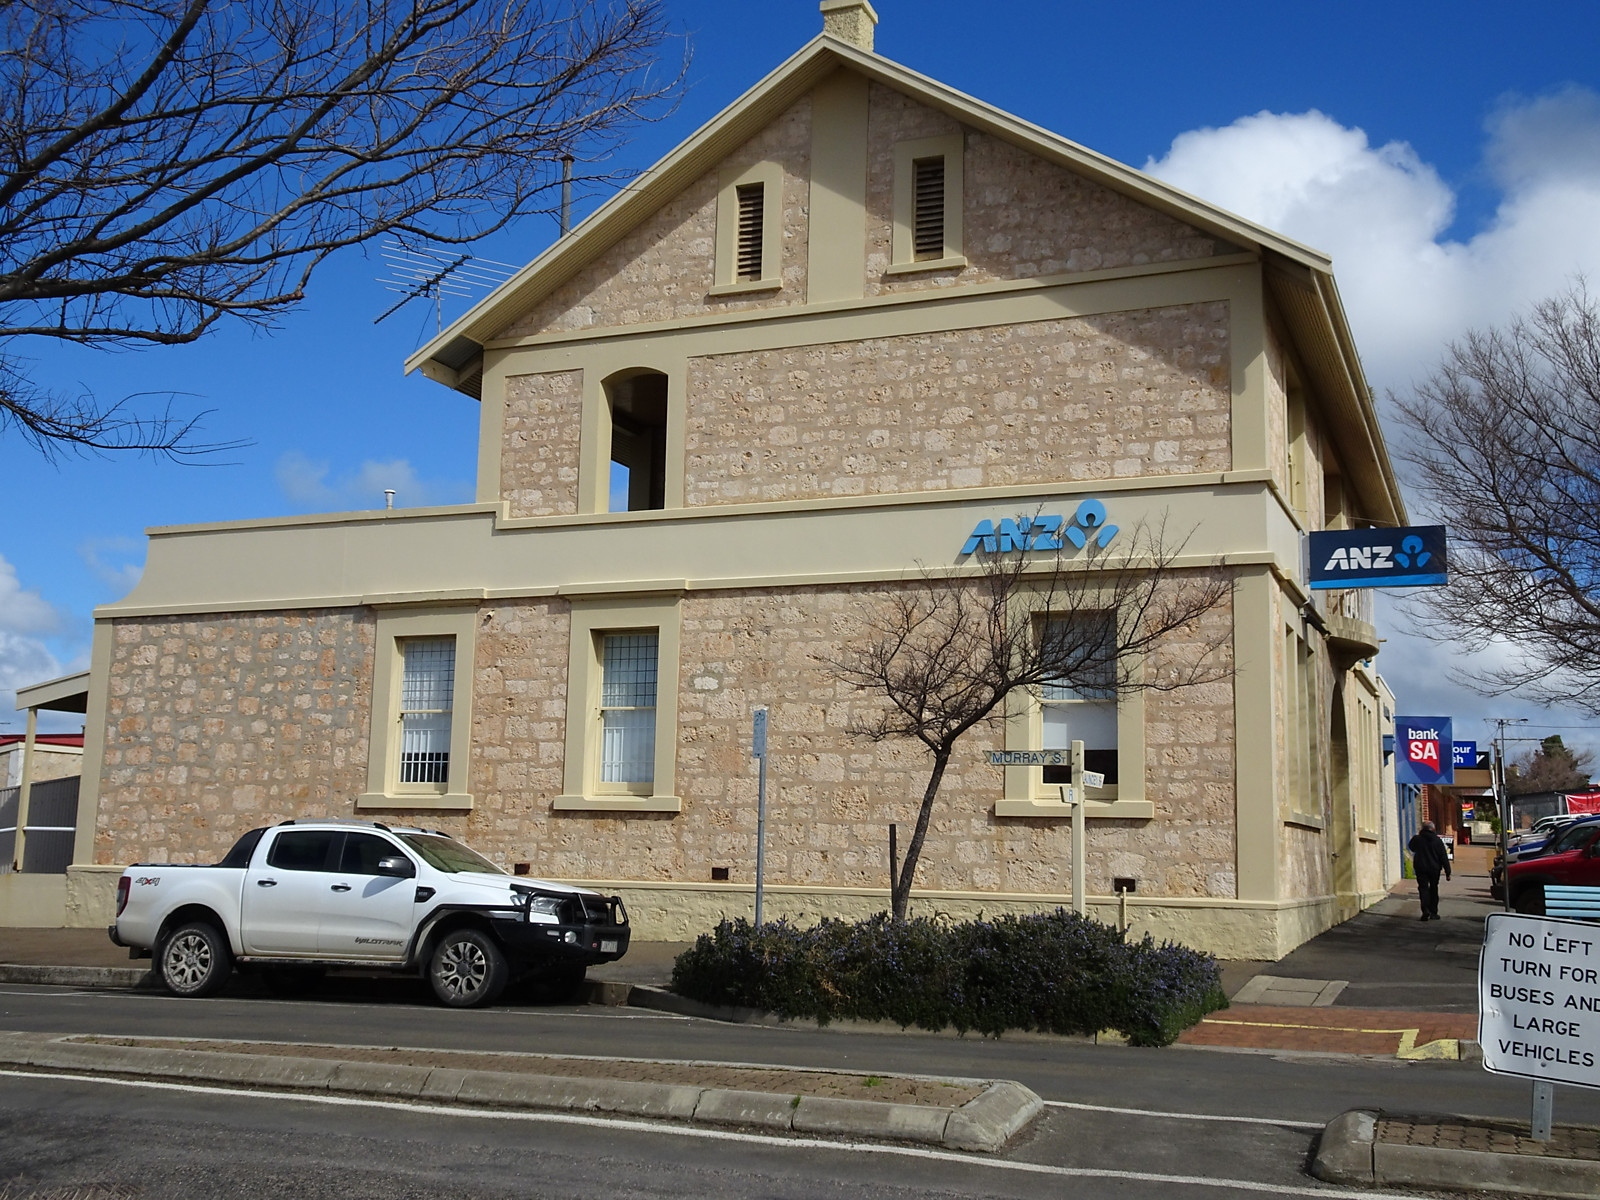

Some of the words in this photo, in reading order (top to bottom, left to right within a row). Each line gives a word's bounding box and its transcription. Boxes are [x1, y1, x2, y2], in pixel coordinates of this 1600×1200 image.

[960, 514, 1064, 555] ANZ
[1324, 546, 1394, 571] ANZ
[1408, 728, 1439, 740] bank
[992, 752, 1048, 764] MURRAY
[1410, 741, 1438, 760] SA
[354, 936, 404, 947] WILDTRAK
[1508, 932, 1535, 949] NO
[1543, 936, 1593, 956] LEFT
[1500, 957, 1551, 978] TURN
[1559, 966, 1598, 985] FOR
[1490, 983, 1555, 1006] BUSES
[1513, 1014, 1581, 1038] LARGE
[1498, 1038, 1594, 1068] VEHICLES
